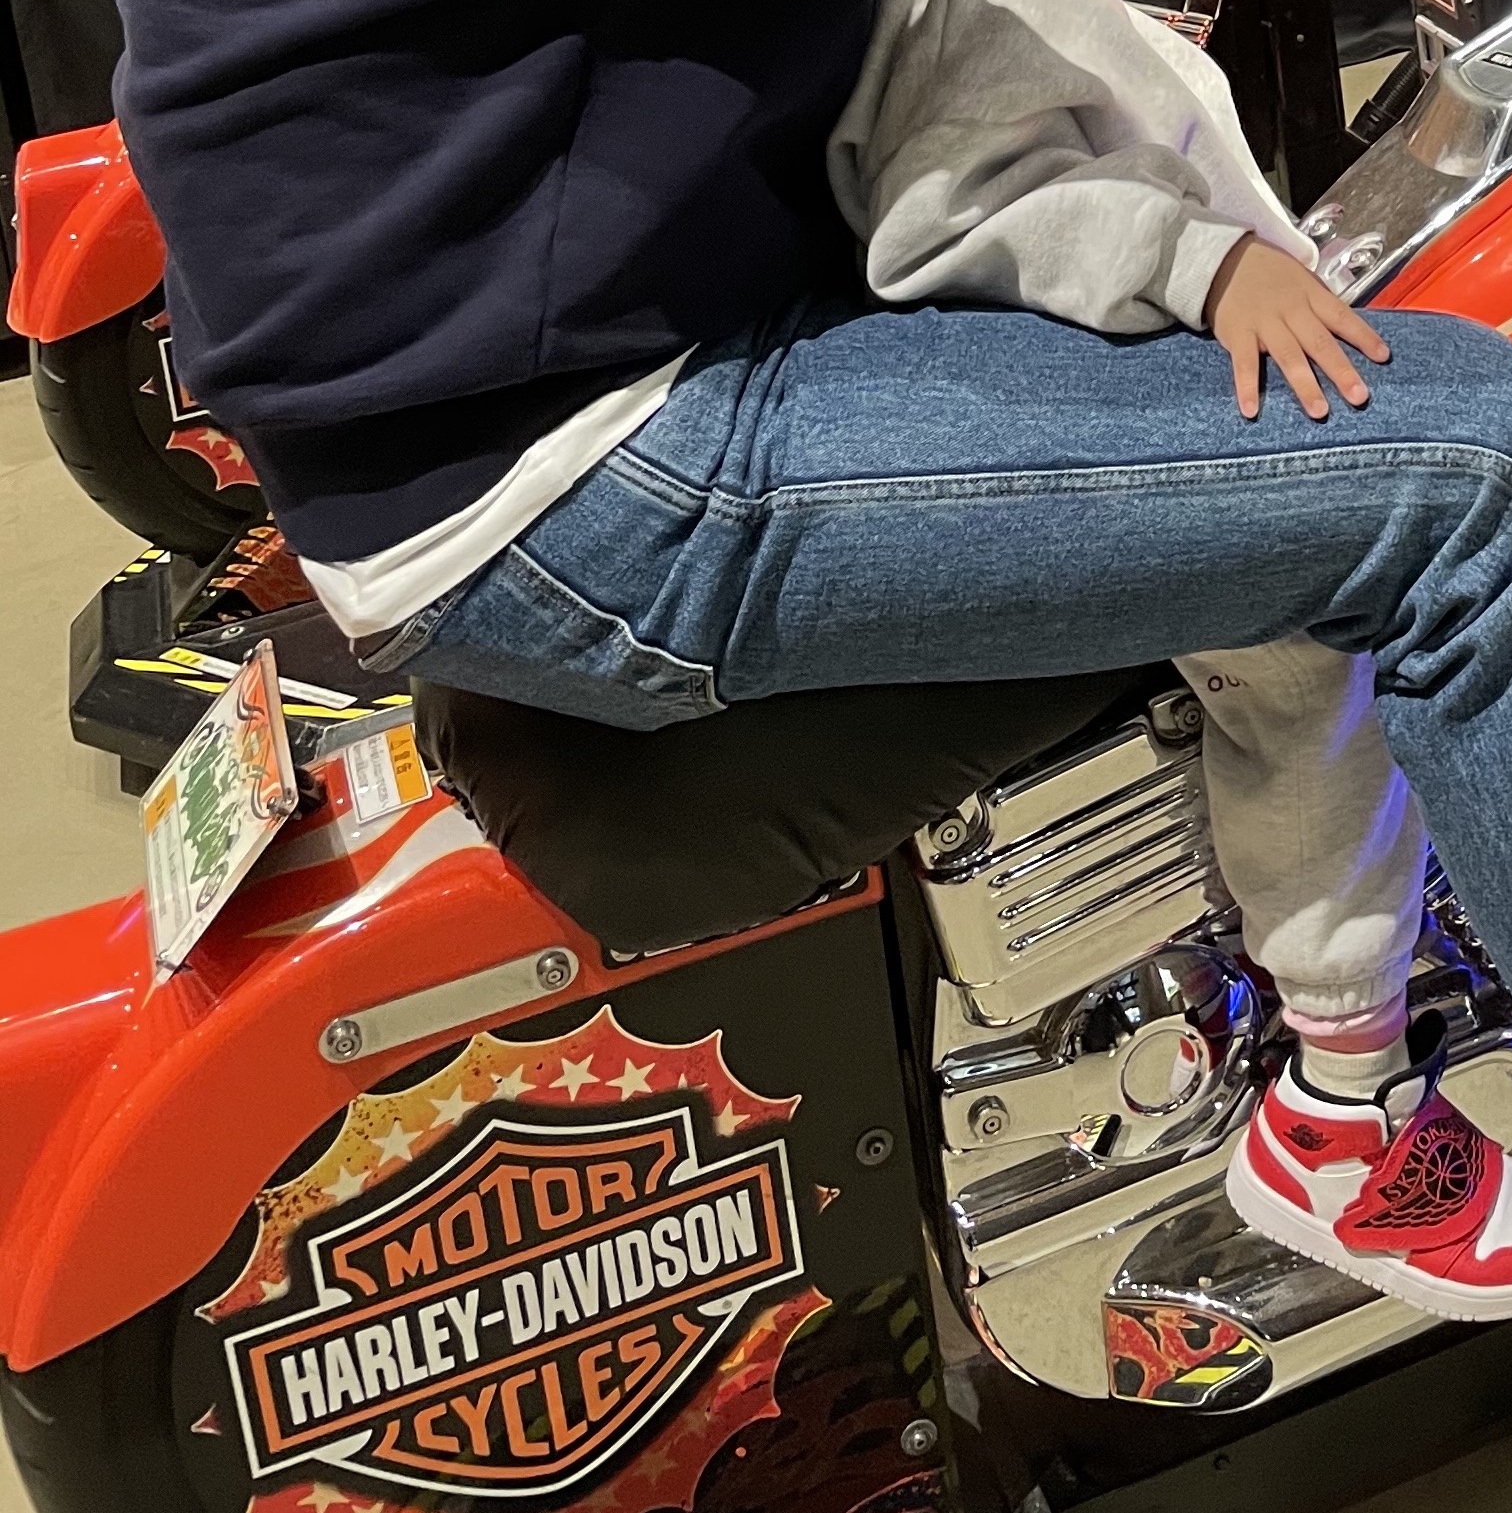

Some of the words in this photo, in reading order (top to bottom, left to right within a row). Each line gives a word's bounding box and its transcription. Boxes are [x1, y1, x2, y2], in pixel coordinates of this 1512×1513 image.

[384, 1160, 640, 1288] MOTOR
[279, 1190, 759, 1426] HARLEY-DAVIDSON
[416, 1323, 662, 1458] CYCLES
